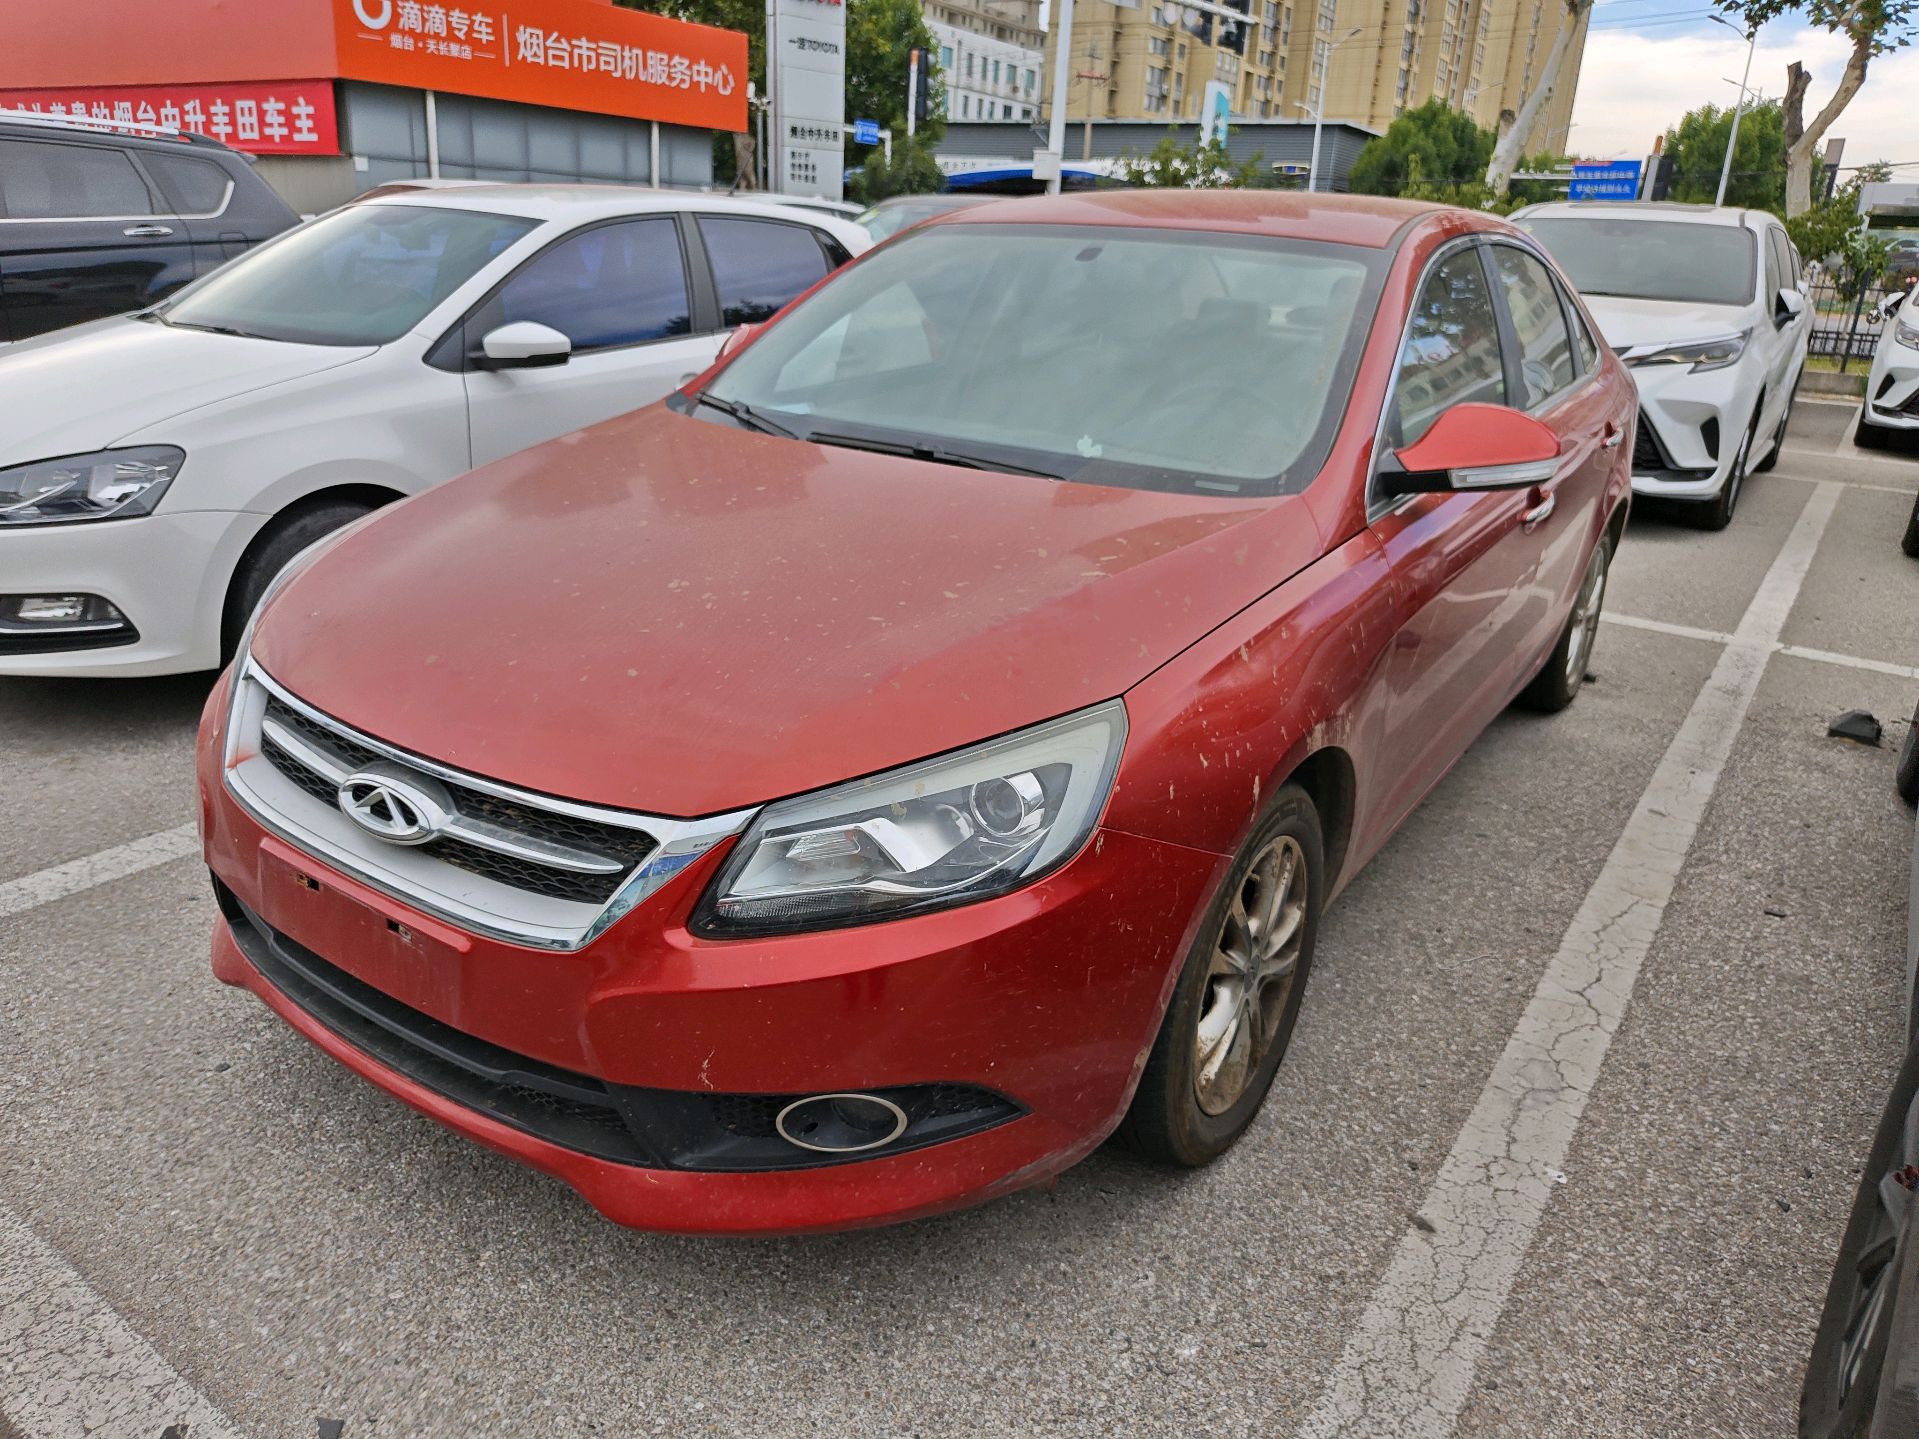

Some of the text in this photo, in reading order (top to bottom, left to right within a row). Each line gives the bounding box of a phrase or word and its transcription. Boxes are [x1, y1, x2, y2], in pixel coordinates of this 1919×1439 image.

[397, 0, 495, 44] 滴滴专车
[516, 24, 736, 97] 烟台市司机服务中心
